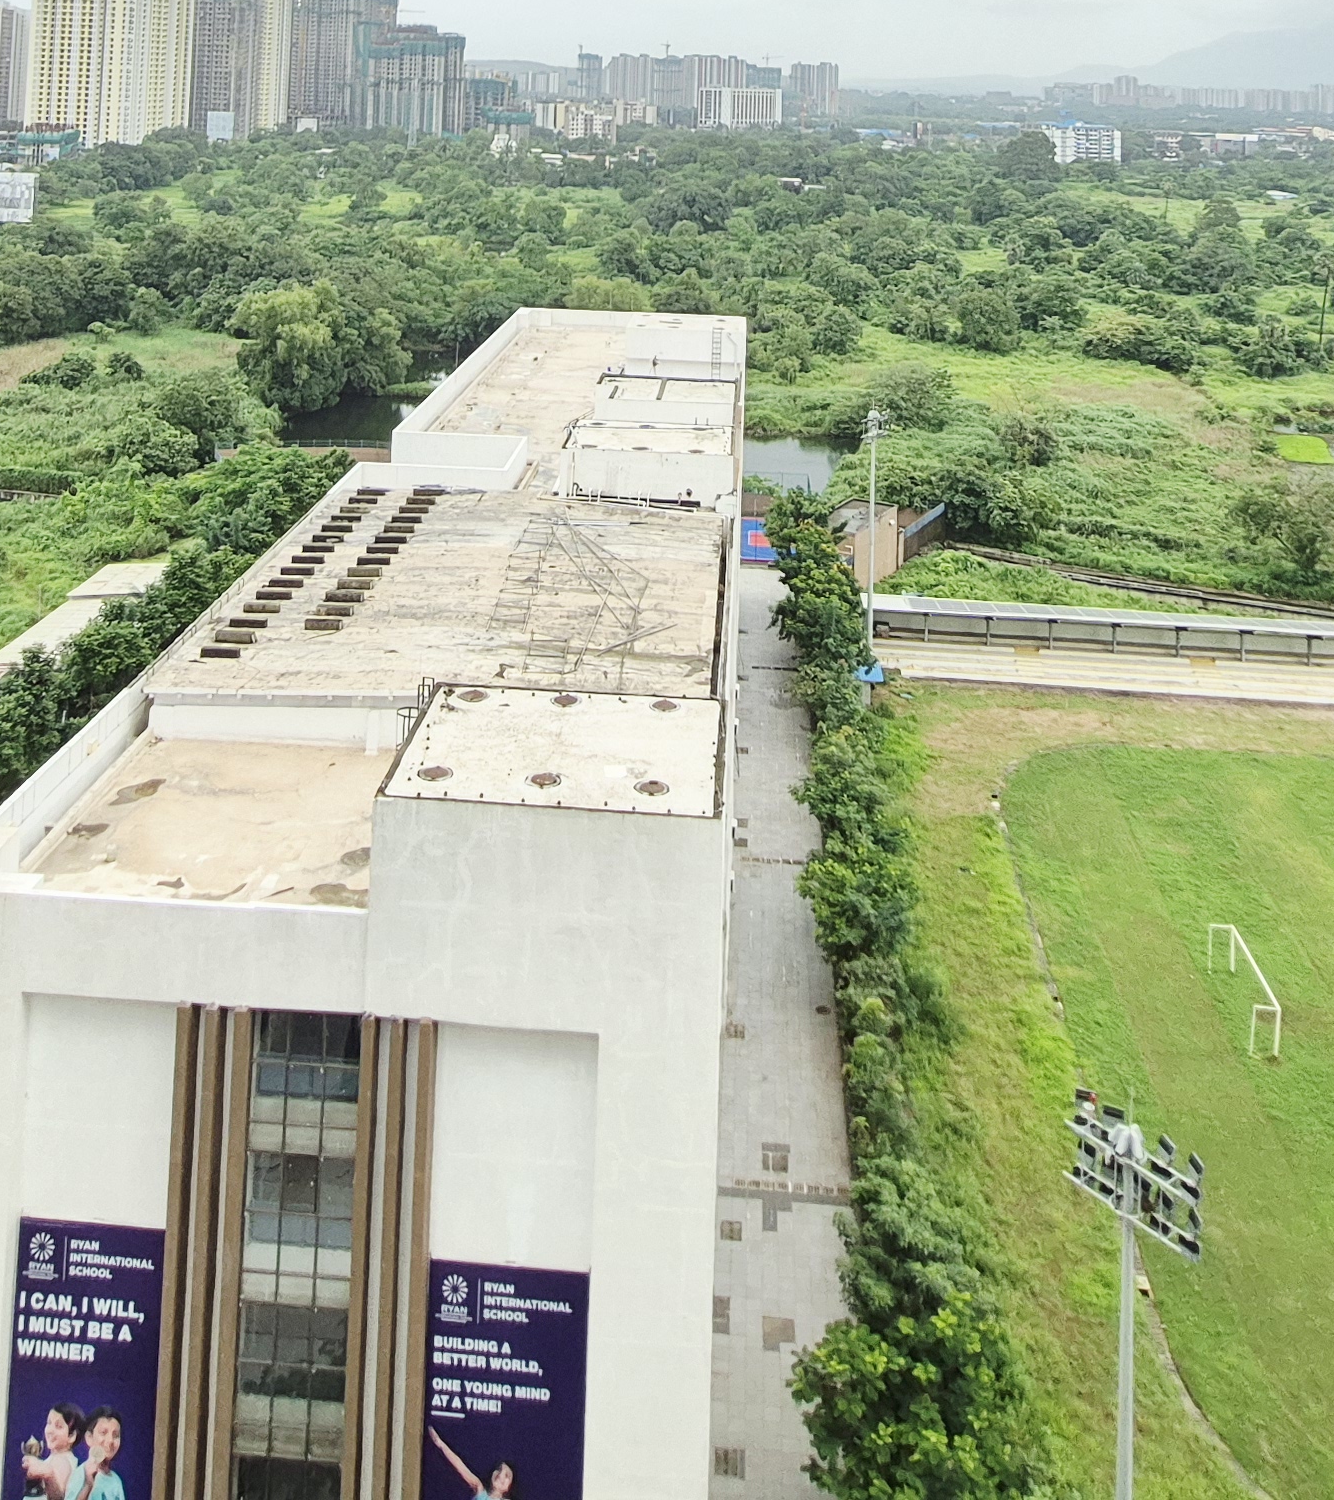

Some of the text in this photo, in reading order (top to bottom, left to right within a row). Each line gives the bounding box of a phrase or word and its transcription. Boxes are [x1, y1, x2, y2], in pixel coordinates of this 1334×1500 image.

[70, 1239, 100, 1251] RYAN
[28, 1261, 54, 1271] RYAN
[69, 1252, 155, 1270] INTERNATIONAL
[68, 1265, 113, 1279] SCHOOL
[483, 1281, 515, 1294] RYAN
[19, 1290, 145, 1324] I CAN, I WILL,
[441, 1304, 467, 1314] RYAN
[483, 1295, 573, 1313] INTERNATIONAL
[482, 1308, 529, 1323] SCHOOL
[17, 1314, 133, 1342] I MUST BE A
[17, 1338, 95, 1363] WINNER
[433, 1335, 512, 1355] BUILDING A
[433, 1351, 543, 1377] BETTER WORLD,
[432, 1377, 551, 1402] ONE YOUNG MIND
[431, 1394, 502, 1414] AT A TIME!
